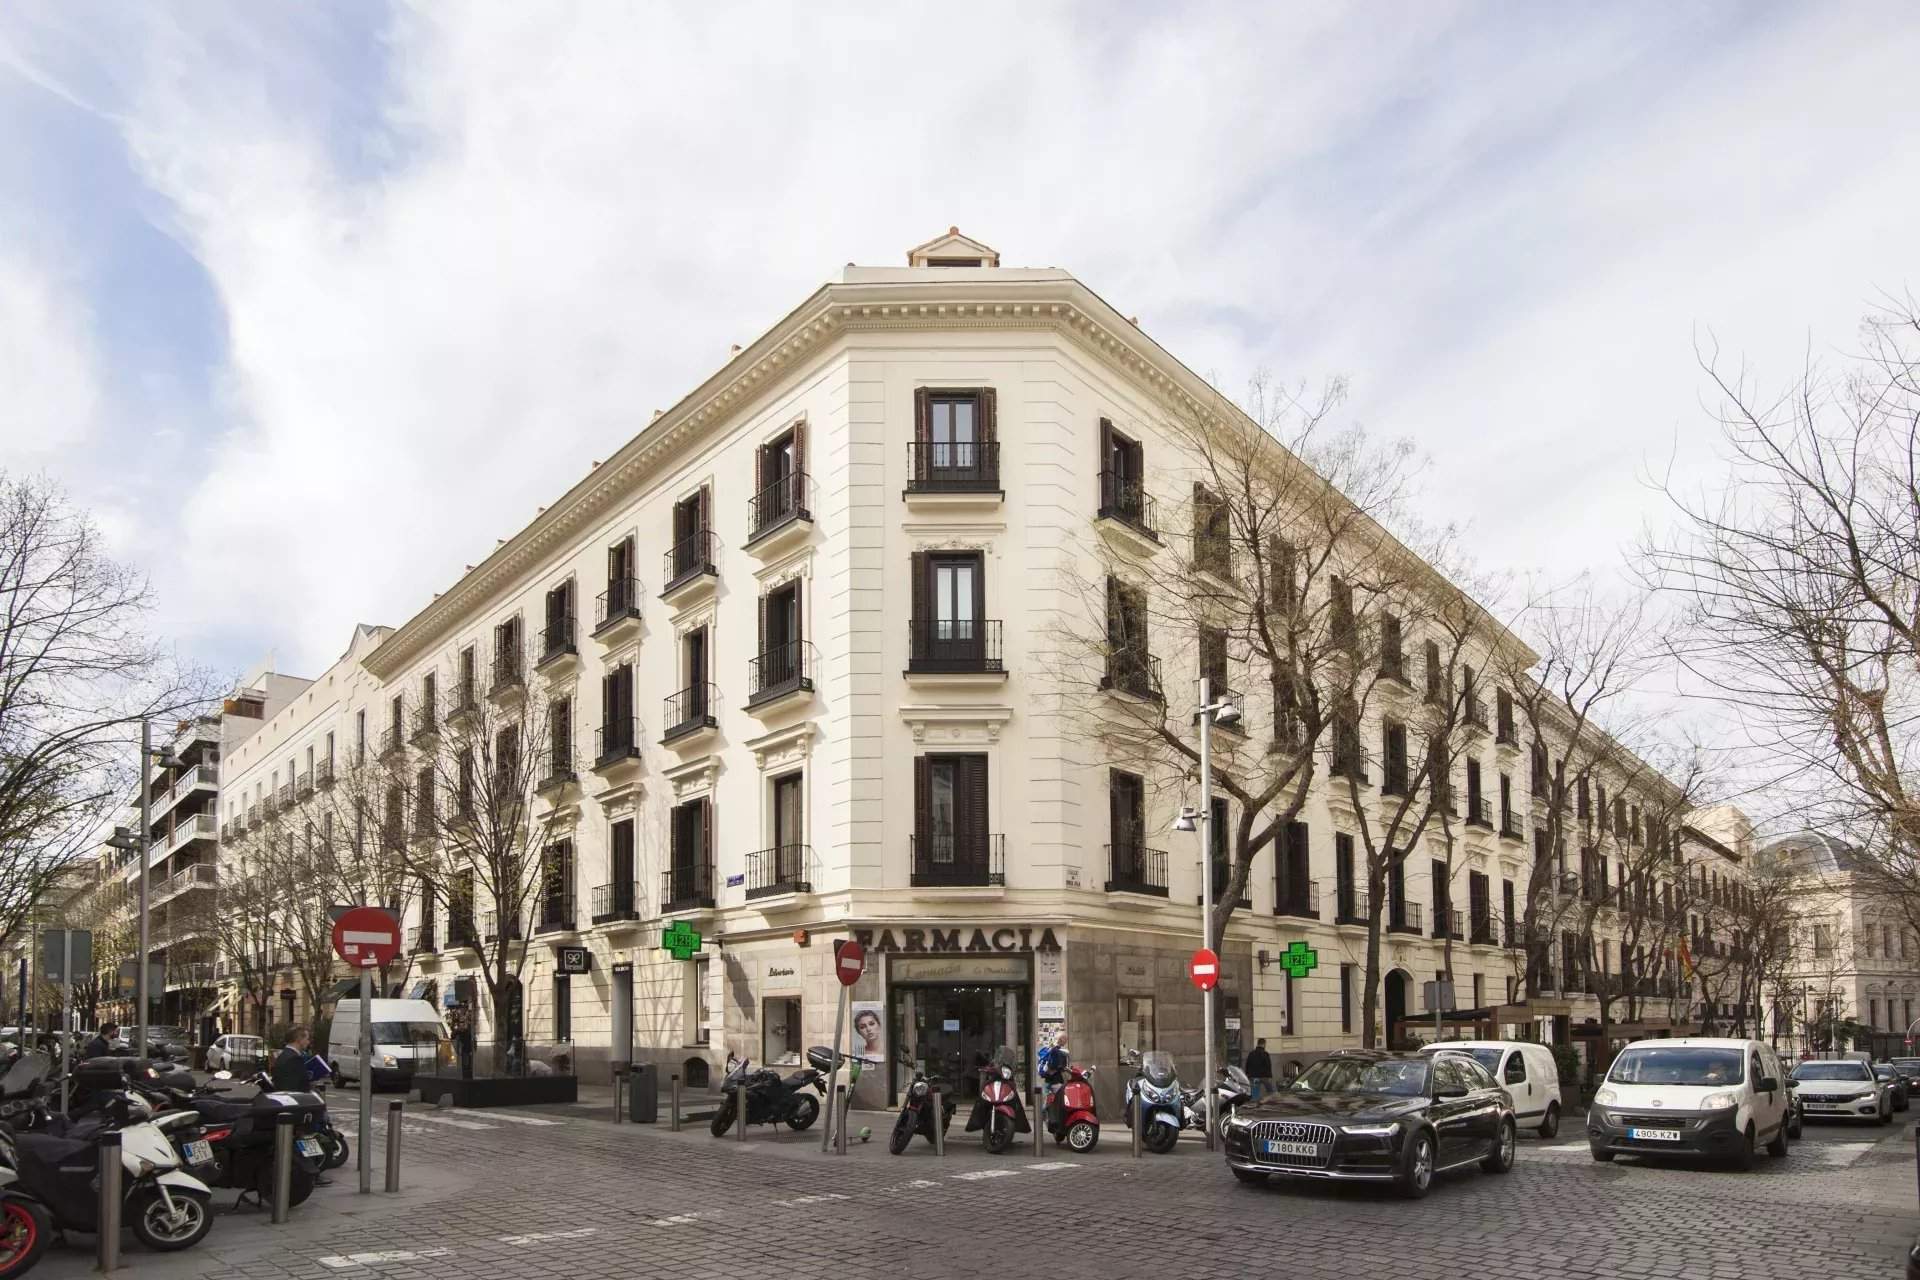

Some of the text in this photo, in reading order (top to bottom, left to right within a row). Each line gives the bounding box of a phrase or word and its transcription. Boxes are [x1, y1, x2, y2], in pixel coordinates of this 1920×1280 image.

[855, 928, 1061, 951] FARMACIA
[1270, 1142, 1315, 1154] 7180 KKG
